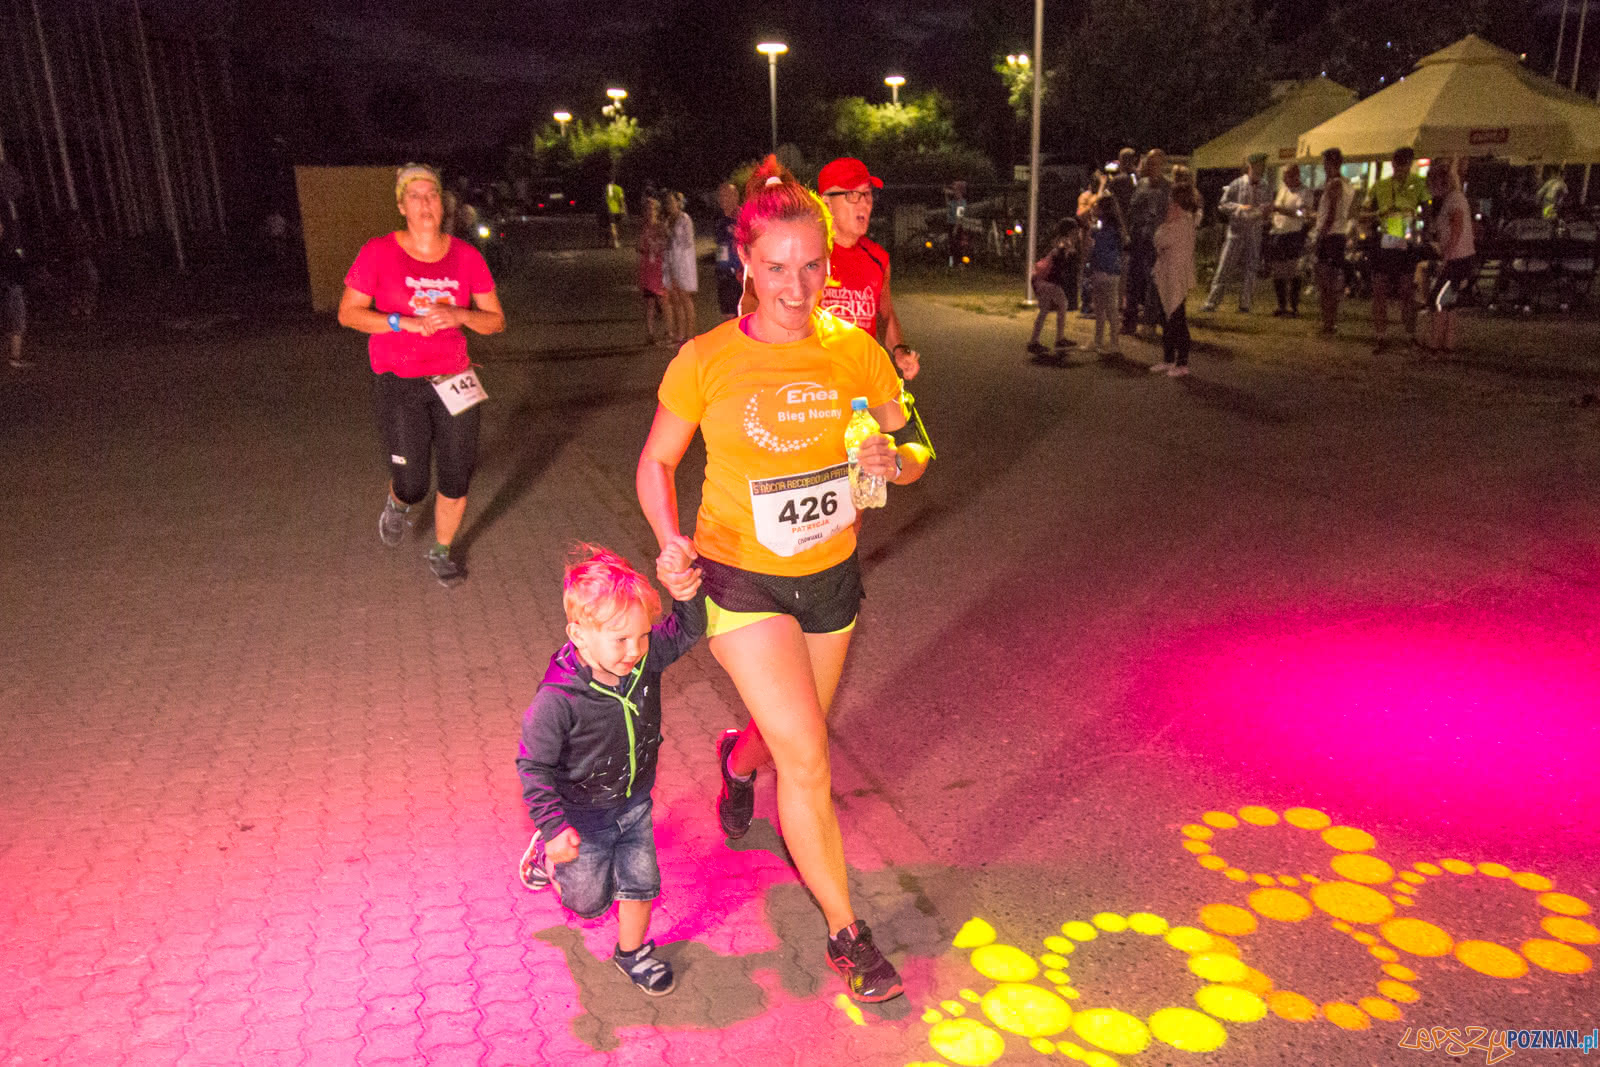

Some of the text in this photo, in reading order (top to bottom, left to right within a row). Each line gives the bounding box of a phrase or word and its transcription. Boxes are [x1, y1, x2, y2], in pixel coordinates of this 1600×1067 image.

[450, 375, 476, 394] 142
[787, 389, 838, 404] Enea
[777, 408, 842, 423] Bieg Nocny
[778, 491, 838, 525] 426
[791, 519, 830, 533] PATRYCJA
